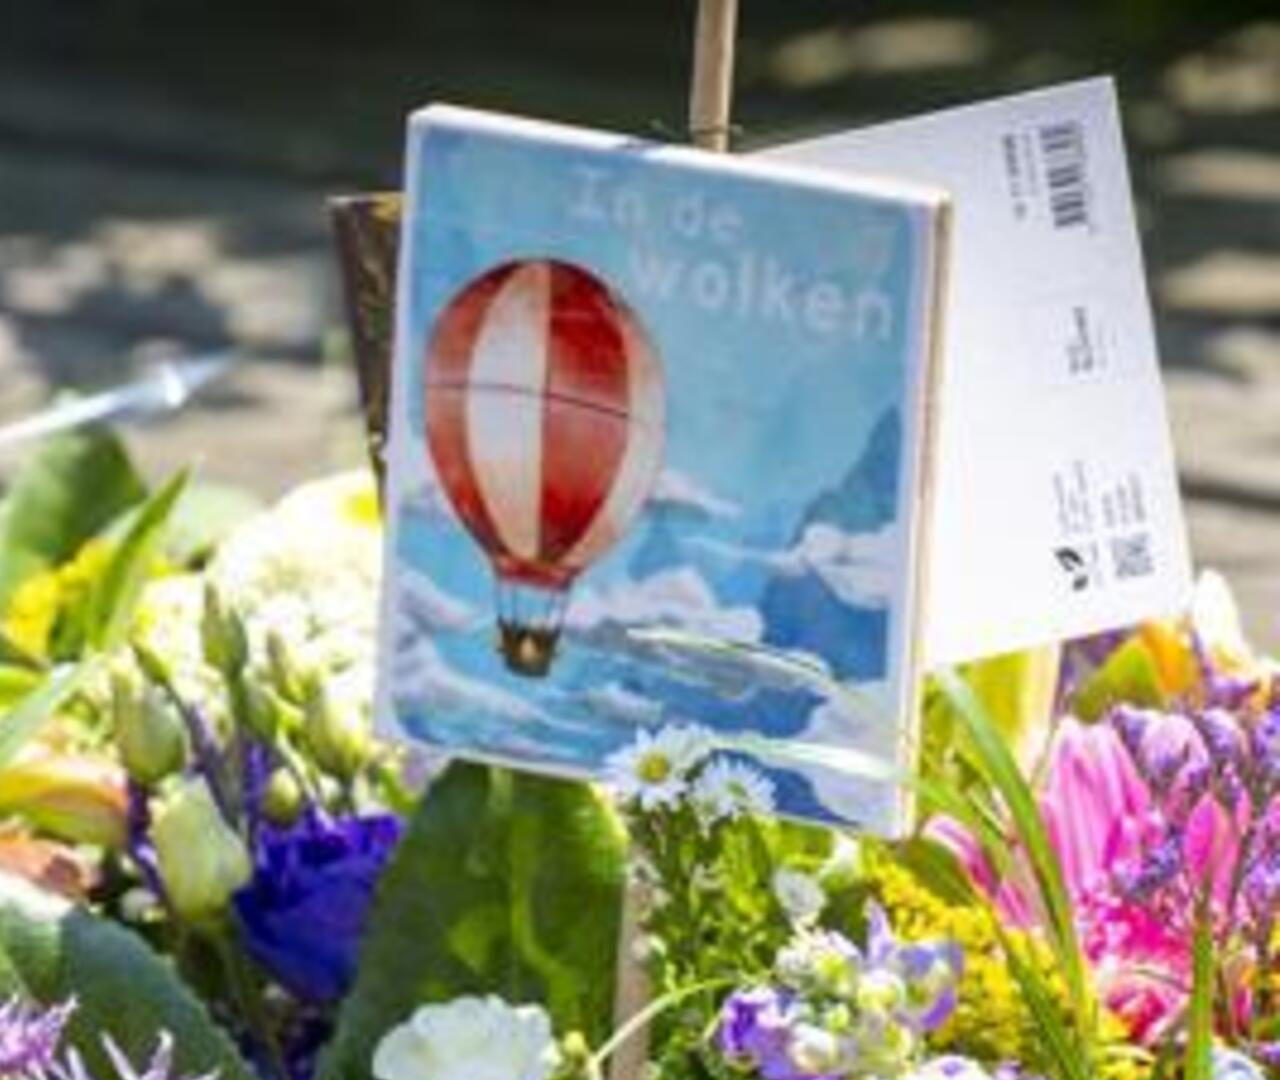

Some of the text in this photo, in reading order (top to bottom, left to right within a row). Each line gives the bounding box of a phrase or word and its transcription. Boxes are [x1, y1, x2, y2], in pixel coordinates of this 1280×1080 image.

[571, 166, 743, 242] In de
[629, 248, 893, 340] wolken
